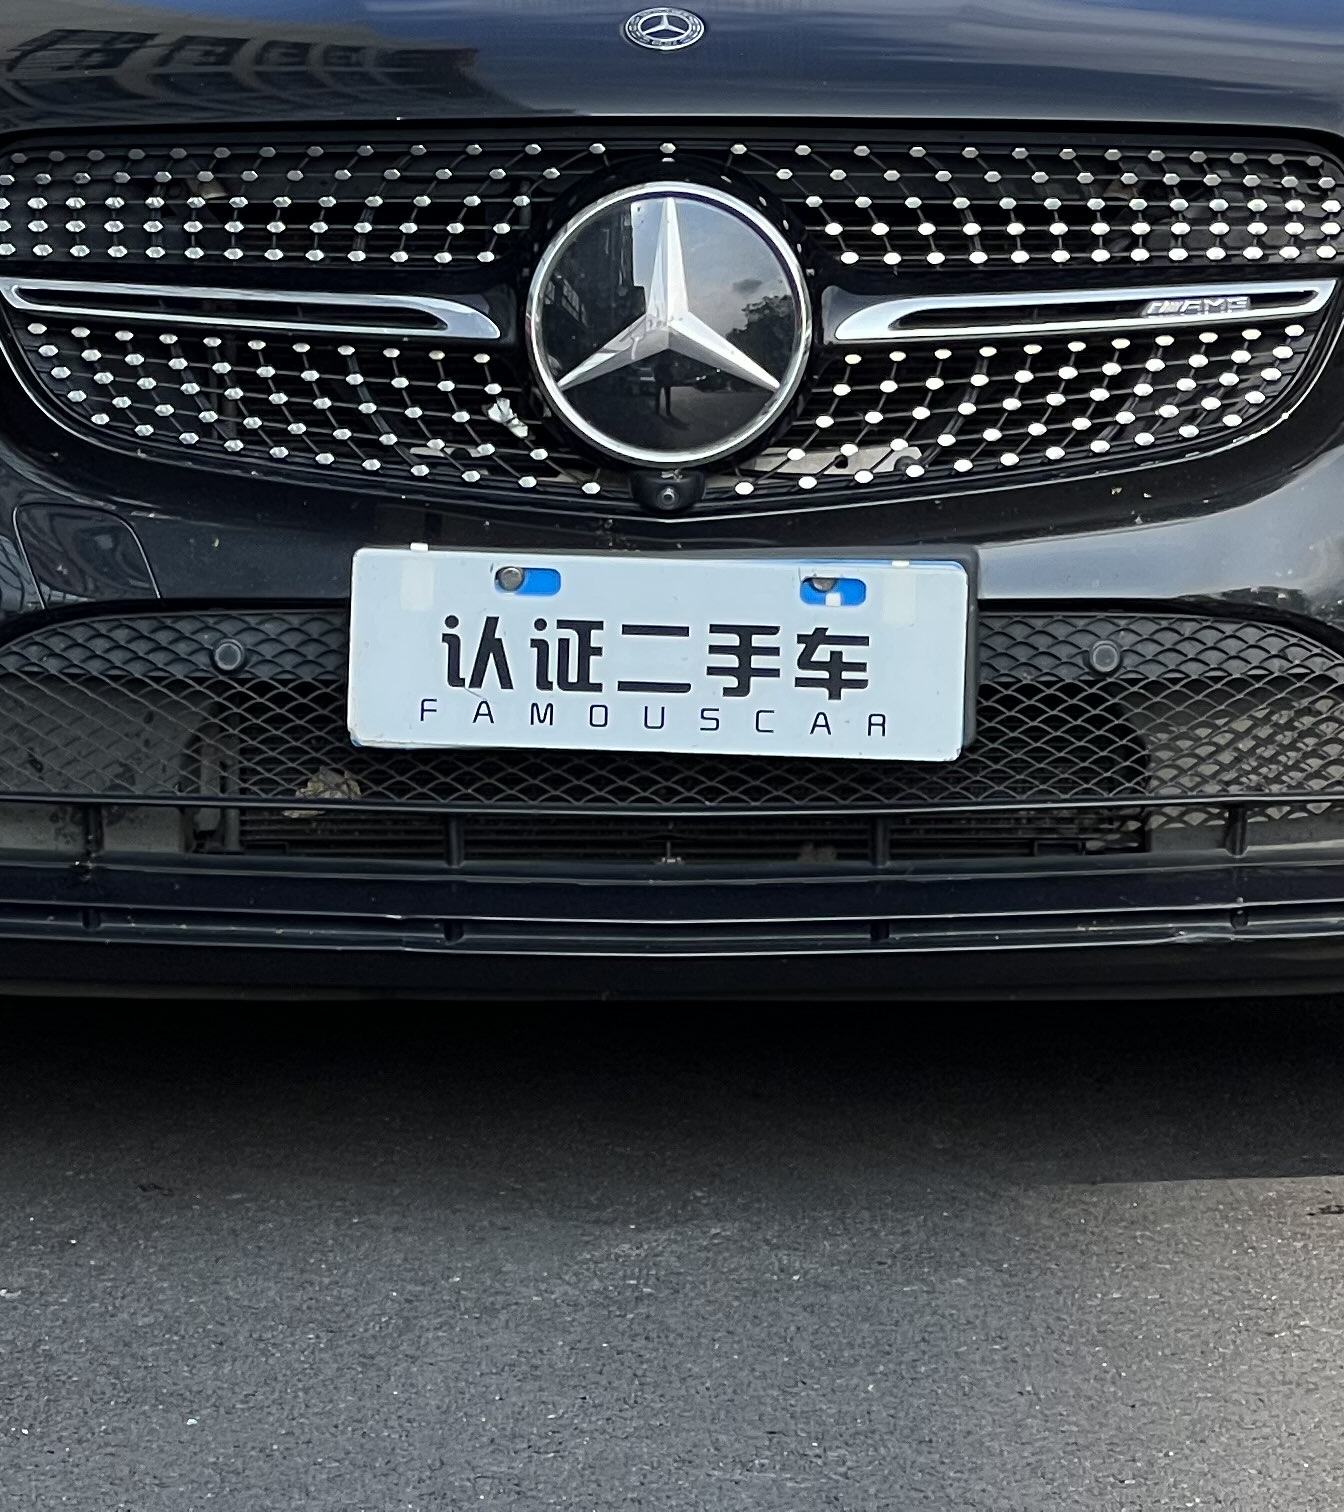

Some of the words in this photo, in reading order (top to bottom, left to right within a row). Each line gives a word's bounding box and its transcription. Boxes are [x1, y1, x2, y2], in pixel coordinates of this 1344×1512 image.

[440, 614, 870, 701] 认证二手车
